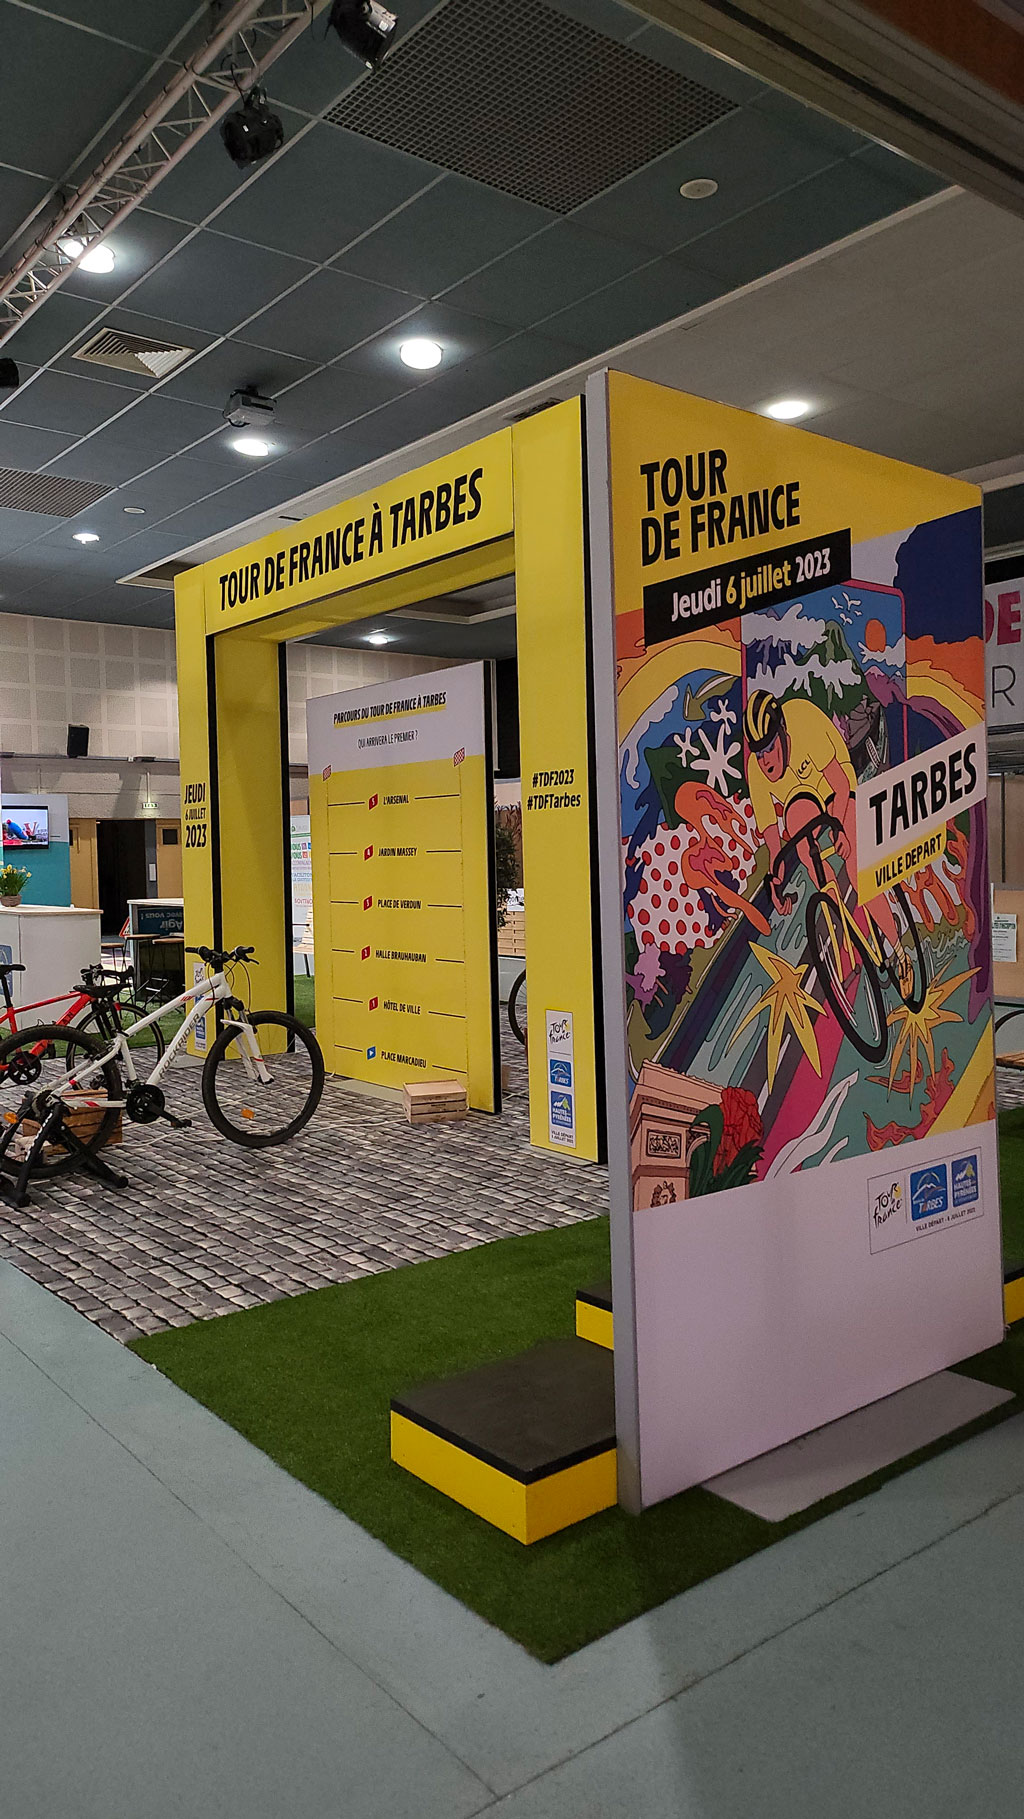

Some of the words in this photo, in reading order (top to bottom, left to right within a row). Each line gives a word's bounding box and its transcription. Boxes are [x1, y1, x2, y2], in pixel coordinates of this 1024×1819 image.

[640, 448, 728, 513] TOUR
[641, 508, 681, 567] DE
[690, 481, 801, 554] FRANCE
[219, 565, 260, 611] TOUR
[264, 551, 286, 596] DE
[289, 517, 365, 588] FRANCE
[368, 502, 384, 558] À
[389, 467, 484, 548] TARBES
[671, 581, 723, 622] Jeudi
[725, 572, 738, 606] 6
[740, 559, 793, 611] juillet
[795, 548, 832, 584] 2023
[333, 708, 361, 725] PARCOURS
[361, 704, 370, 719] DU
[370, 704, 385, 717] TOUR
[386, 702, 393, 714] DE
[393, 697, 417, 712] FRANCE
[417, 694, 422, 708] À
[423, 691, 447, 707] TARBES
[358, 738, 366, 749] QUI
[366, 734, 387, 748] ARRIVERA
[388, 732, 394, 744] LE
[394, 730, 415, 743] PREMIER
[532, 768, 575, 788] #TDF2023
[184, 782, 206, 805] JEUDI
[383, 794, 409, 805] L'ARSENAL
[527, 791, 581, 811] #TDFTarbes
[869, 742, 977, 847] TARBES
[185, 808, 189, 821] 6
[188, 807, 206, 820] JUILLET
[185, 823, 207, 848] 2023
[396, 847, 418, 857] MASSEY
[874, 857, 904, 888] VILLE
[905, 833, 942, 869] DEPART
[377, 899, 392, 908] PLACE
[392, 899, 400, 909] DE
[400, 900, 422, 910] VERDUN
[375, 949, 391, 959] HALLE
[383, 1000, 399, 1012] HÔTEL
[399, 1003, 406, 1013] DE
[406, 1004, 421, 1015] VILLE
[159, 1012, 201, 1080] ROCKRIDER
[381, 1050, 396, 1062] PLACE
[396, 1053, 427, 1069] MARCADIEU
